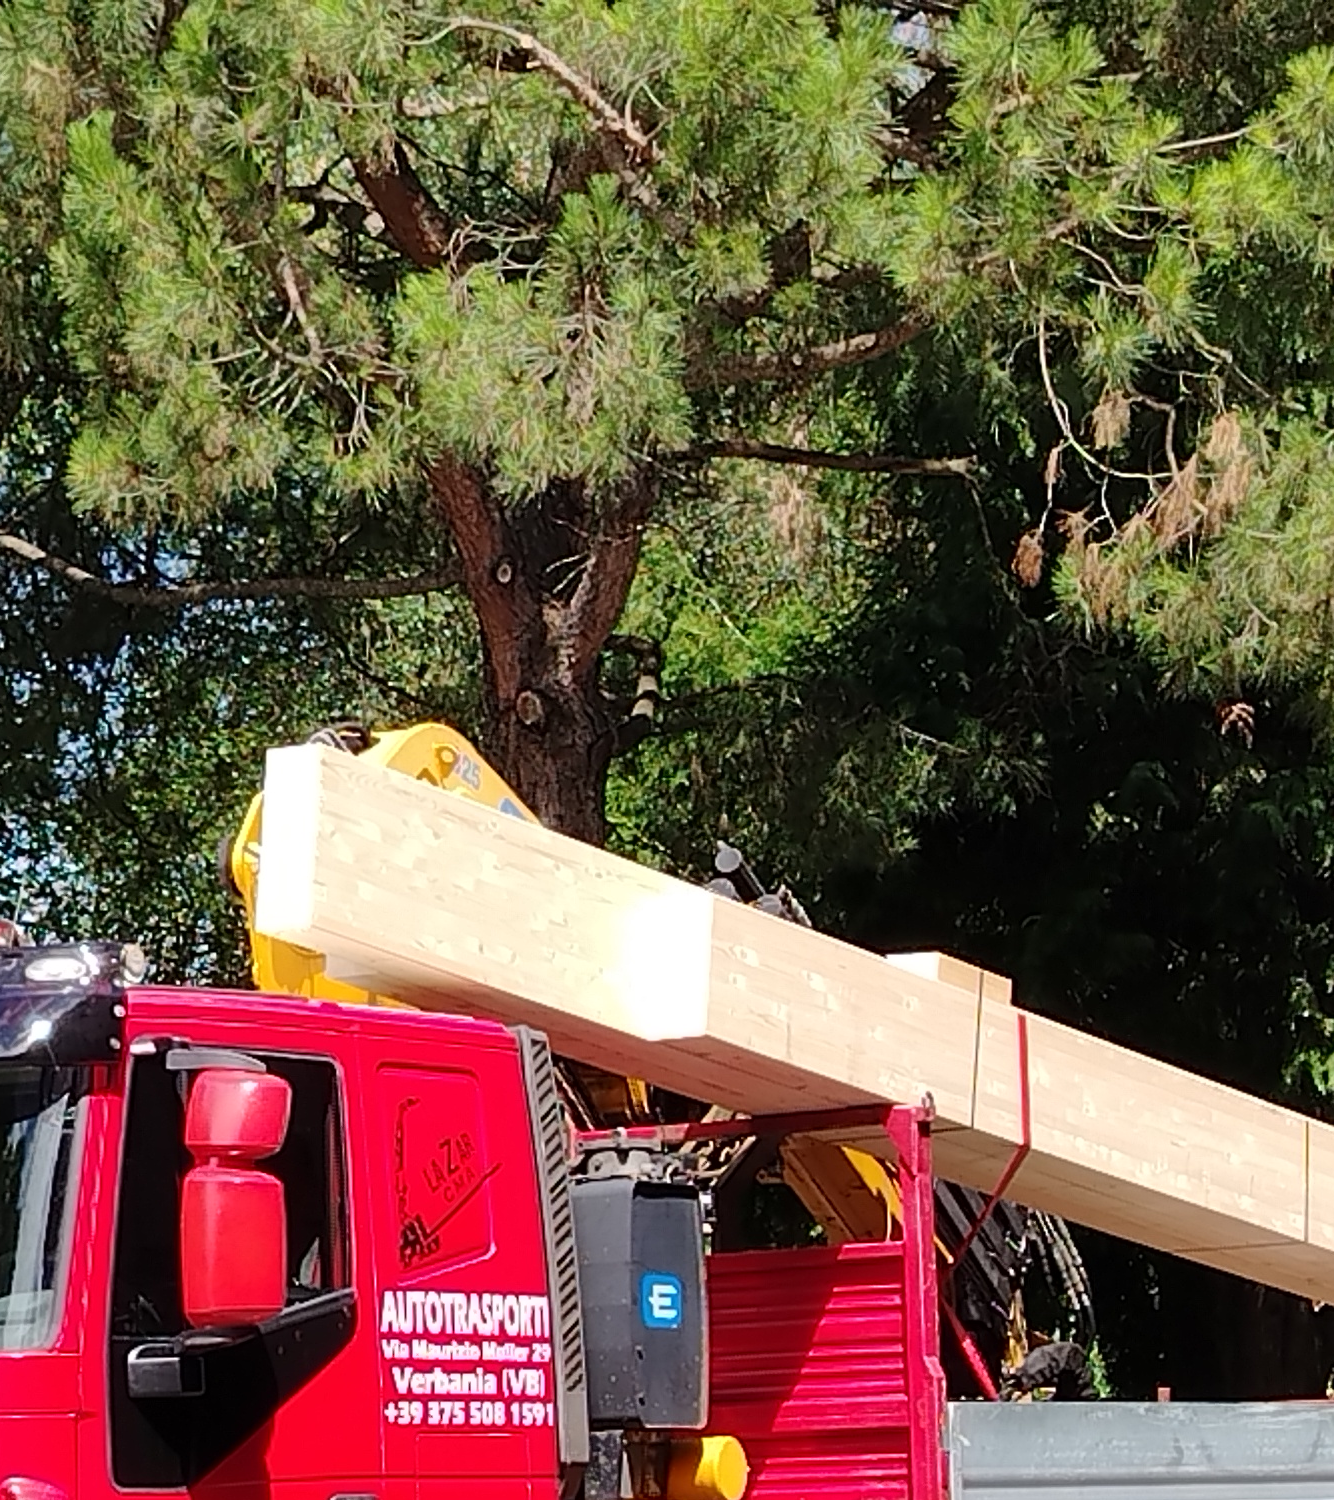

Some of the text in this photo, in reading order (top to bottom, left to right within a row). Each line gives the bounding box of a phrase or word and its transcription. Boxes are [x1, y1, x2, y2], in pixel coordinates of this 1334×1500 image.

[422, 1132, 476, 1194] LAZAR
[380, 1291, 551, 1338] AUTOTRASPORTI
[381, 1339, 410, 1360] Via
[392, 1367, 546, 1398] Verbania (VB)
[384, 1402, 554, 1427] +39 375 508 1591
